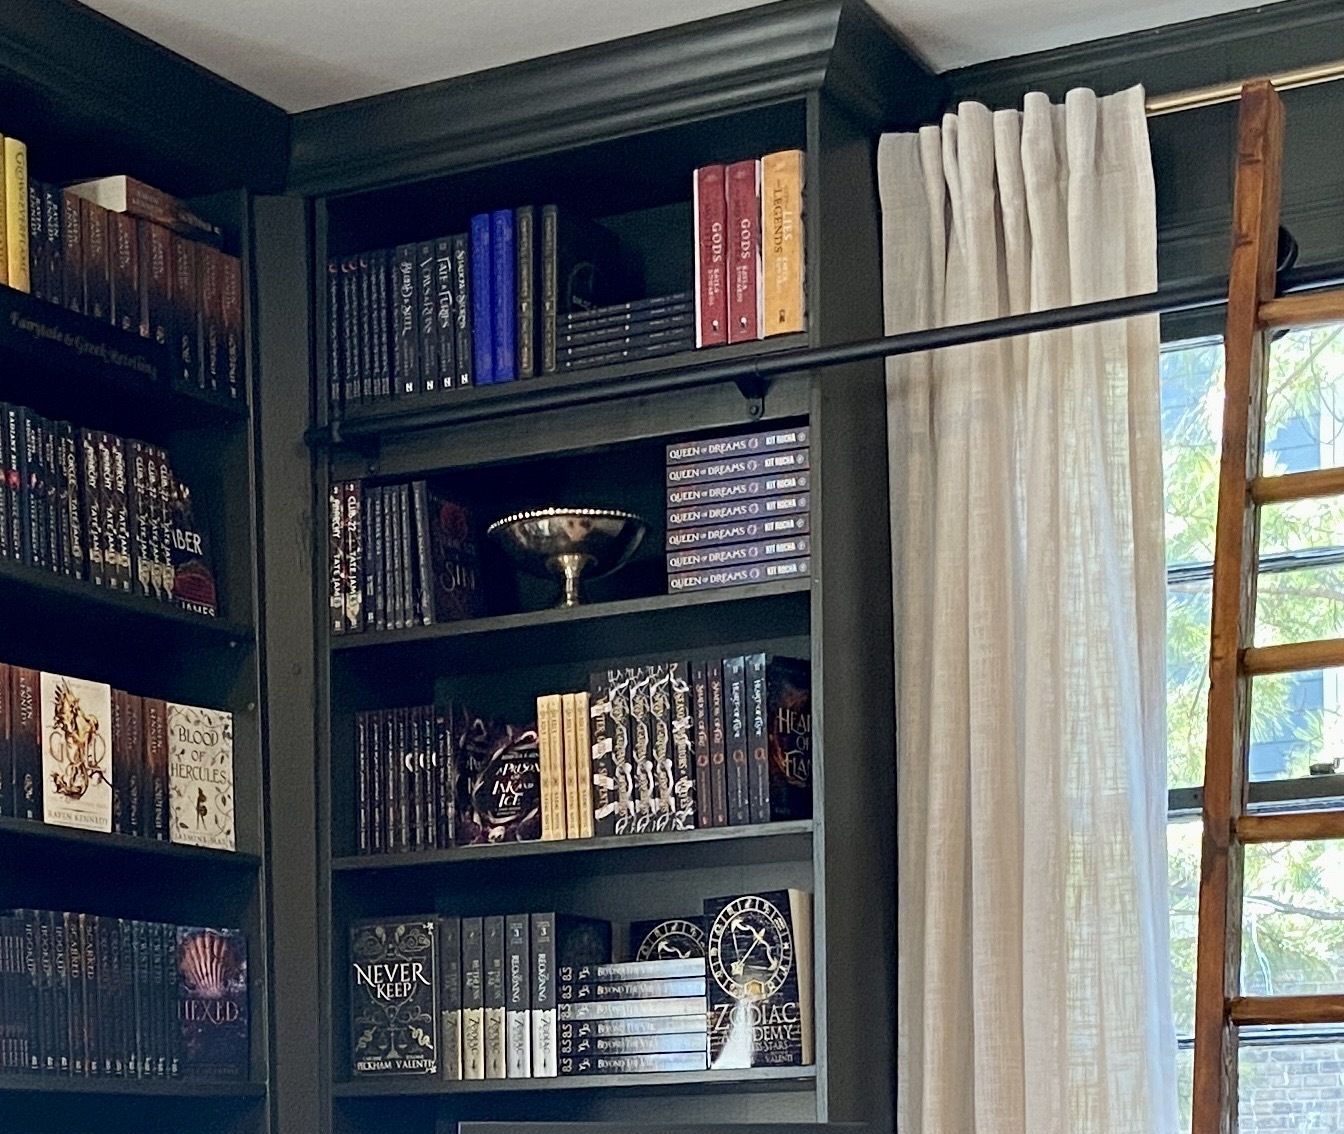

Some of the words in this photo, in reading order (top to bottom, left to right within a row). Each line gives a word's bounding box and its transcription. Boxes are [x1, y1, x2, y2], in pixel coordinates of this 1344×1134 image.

[712, 223, 722, 263] GODS
[741, 219, 750, 259] GODS
[669, 447, 700, 459] QUEEN
[708, 441, 746, 454] DREAMS
[670, 511, 701, 524] QUEEN
[709, 505, 747, 518] DREAMS
[178, 726, 219, 746] BLOOD
[191, 751, 205, 761] OF
[171, 764, 227, 784] HERCULES
[353, 962, 431, 987] NEVER
[376, 982, 412, 1000] KEEP
[177, 1000, 239, 1024] HEXED
